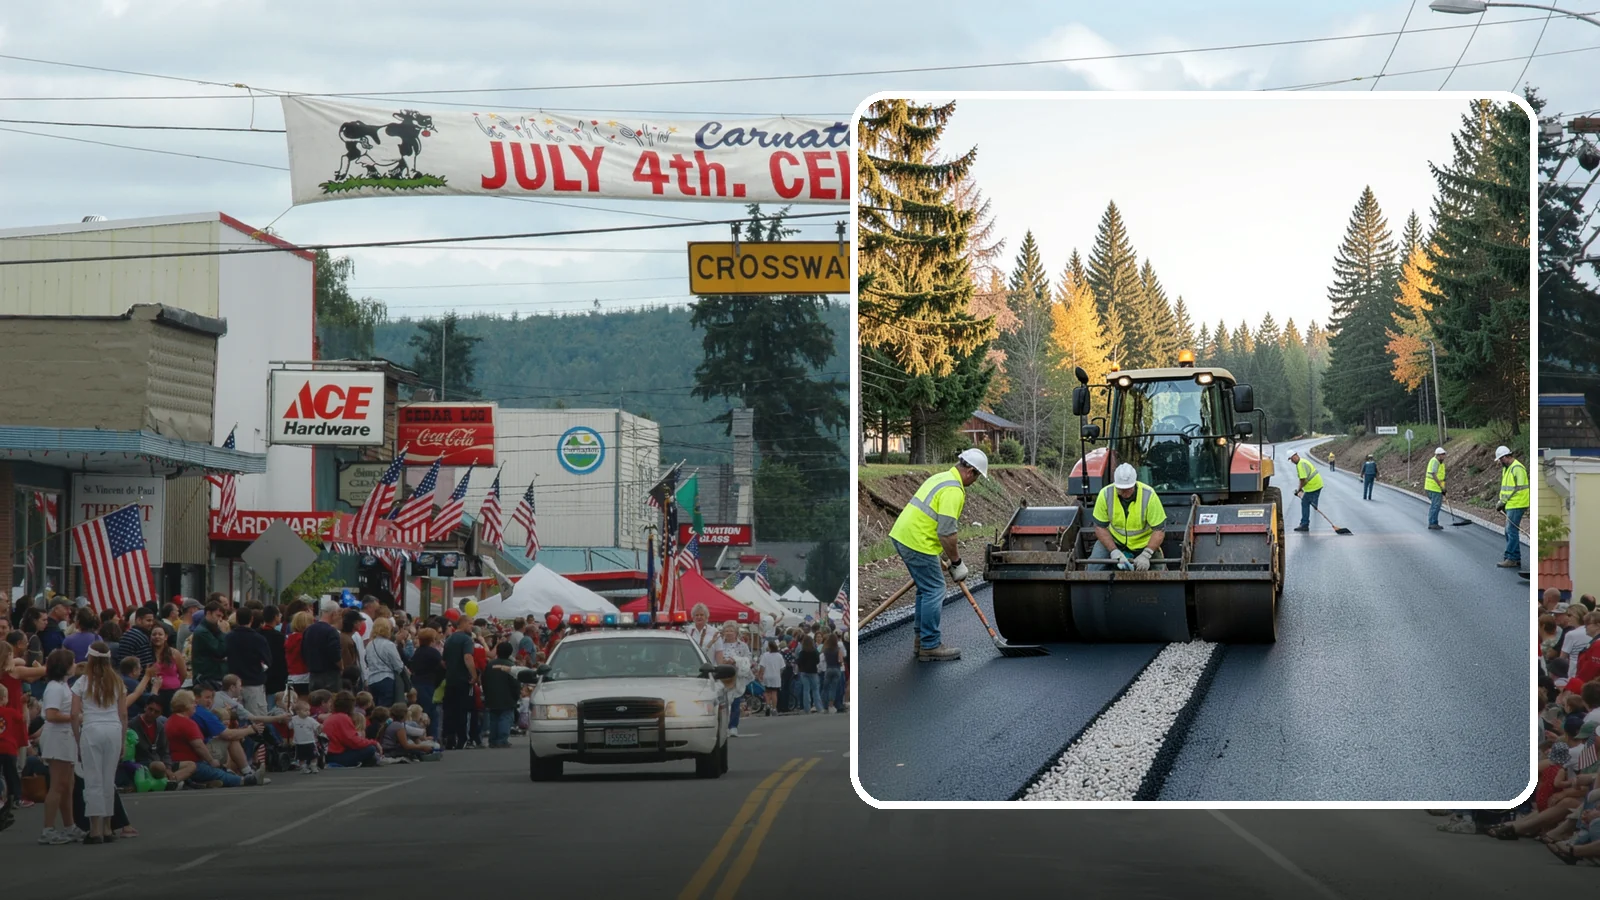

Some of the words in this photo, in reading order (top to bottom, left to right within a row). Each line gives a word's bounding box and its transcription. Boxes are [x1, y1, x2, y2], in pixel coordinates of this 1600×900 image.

[694, 121, 850, 150] Carnat
[481, 141, 605, 193] JULY
[632, 150, 746, 198] 4th.
[697, 254, 850, 280] CROSSWA
[282, 380, 374, 420] ACE
[406, 409, 453, 422] CEDAR
[461, 409, 485, 422] LOG
[283, 421, 371, 437] Hardware
[416, 428, 477, 447] Coca-Cola
[83, 485, 94, 494] St.
[95, 485, 124, 495] Vincent
[126, 486, 136, 495] de
[137, 486, 155, 495] Paul
[212, 515, 331, 536] HARDARE
[688, 526, 742, 535] CRNATION
[699, 535, 731, 543] GLASS
